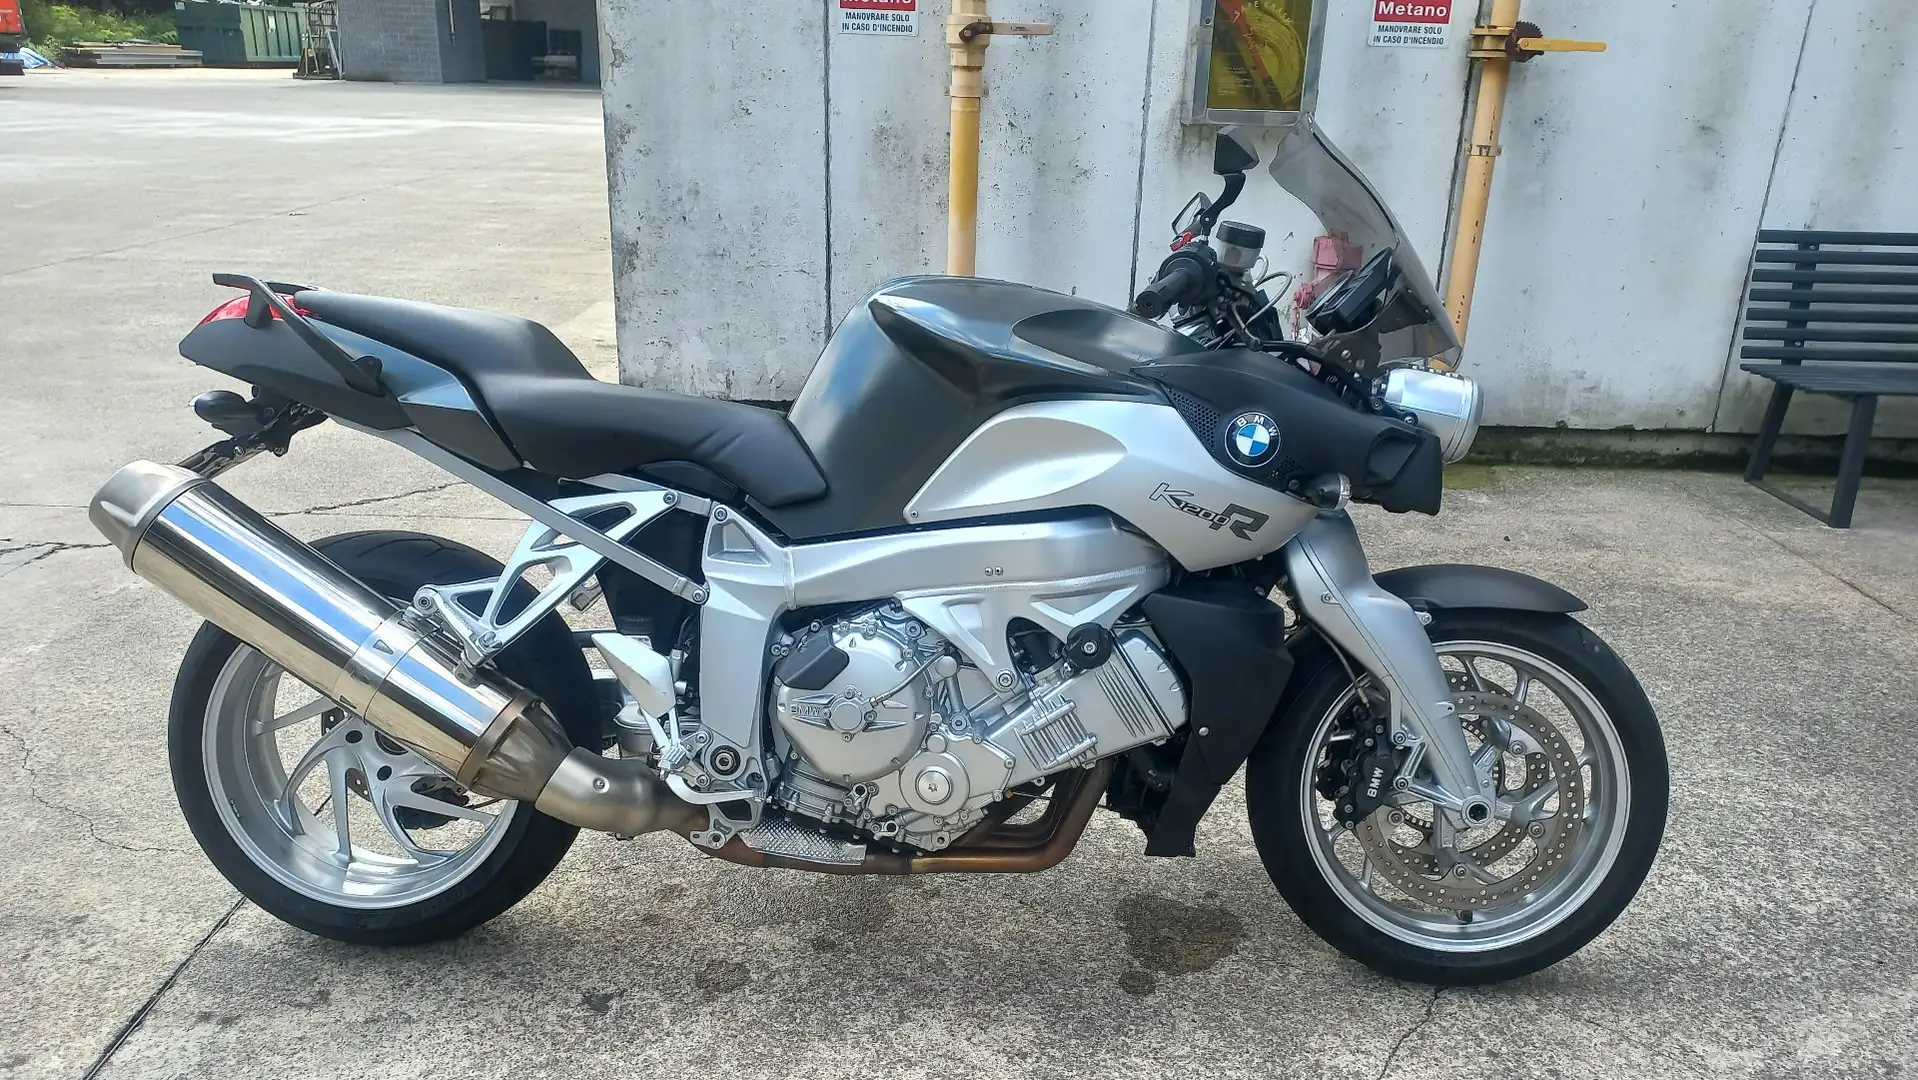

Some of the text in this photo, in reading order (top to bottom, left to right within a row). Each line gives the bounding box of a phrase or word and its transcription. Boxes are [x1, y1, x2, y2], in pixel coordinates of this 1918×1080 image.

[1378, 0, 1447, 17] Metano
[845, 12, 910, 22] MANOVRARE SOLO
[842, 23, 913, 33] IN CASO D'INCENDIO
[1378, 25, 1443, 35] MANOVRARE SOLO
[1382, 36, 1402, 44] CASO
[1403, 36, 1444, 45] D'INCENDIO
[1236, 415, 1278, 438] BMW
[790, 704, 821, 716] BMW
[1366, 767, 1384, 798] BMW
